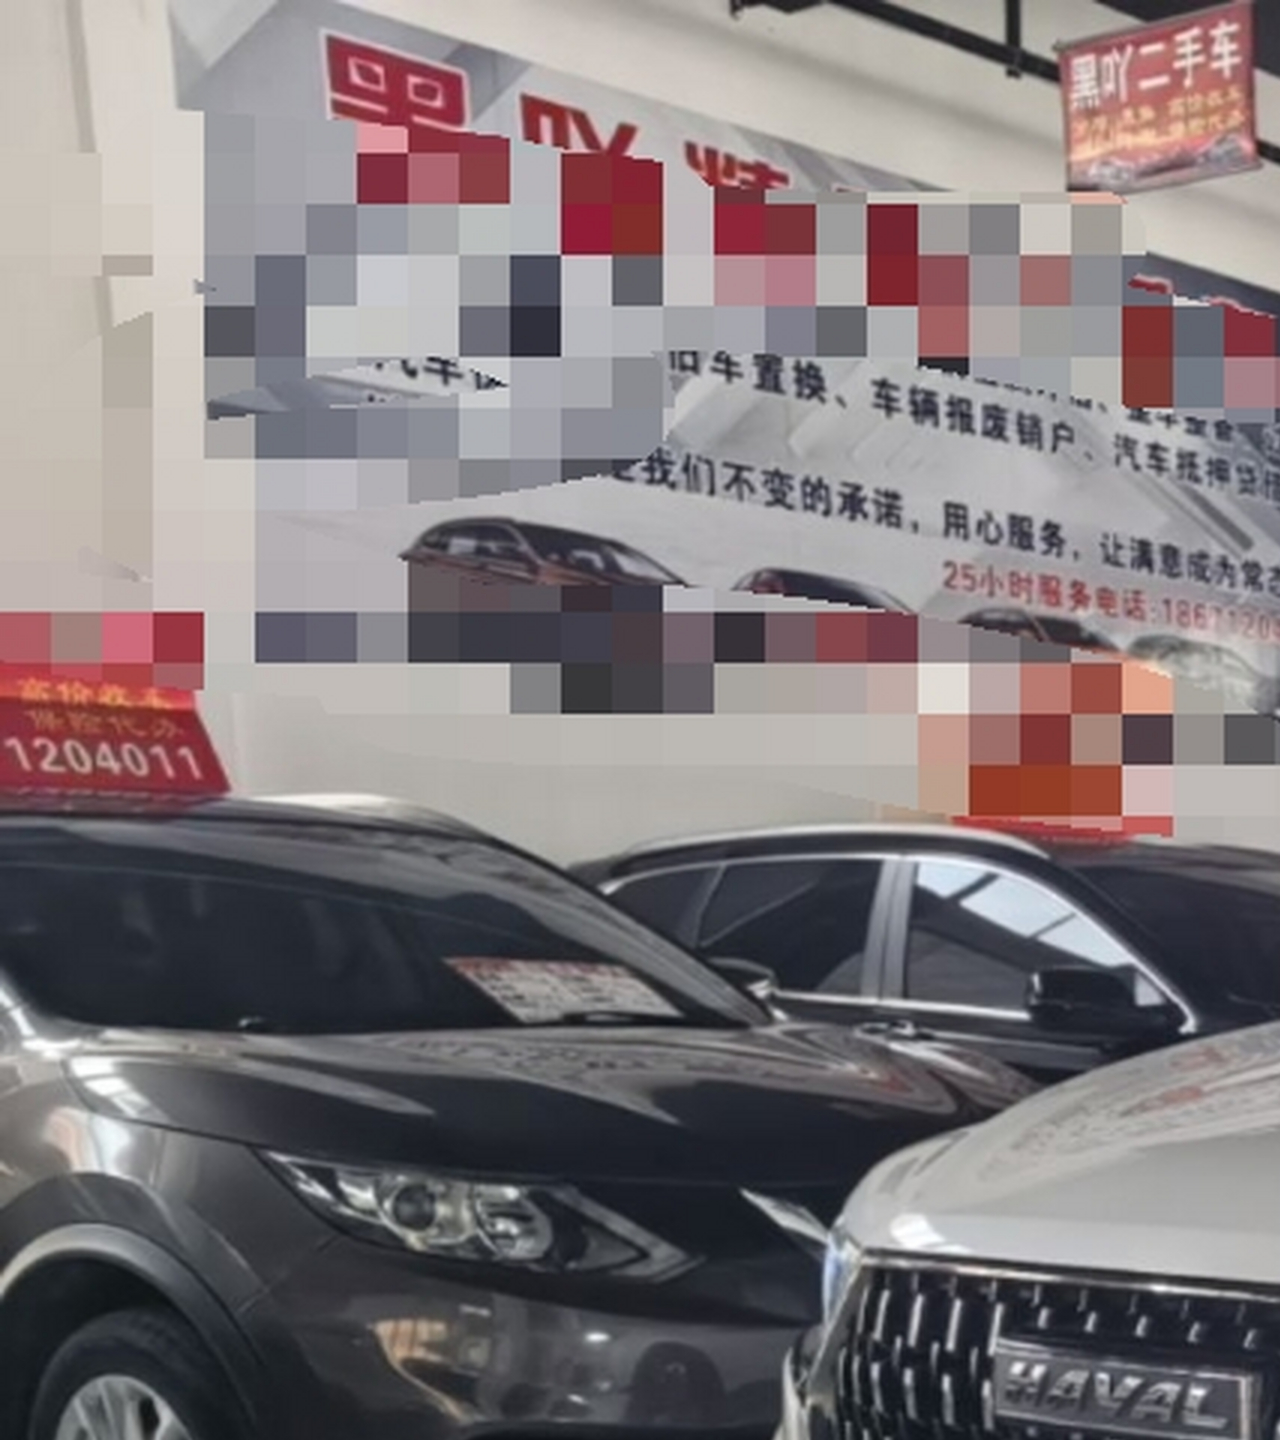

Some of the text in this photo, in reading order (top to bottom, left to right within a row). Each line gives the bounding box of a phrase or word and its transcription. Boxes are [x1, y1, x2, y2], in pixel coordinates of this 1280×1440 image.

[1070, 20, 1243, 108] 黑吖二手车
[5, 737, 202, 780] 1204011
[1005, 1361, 1228, 1429] HAVAL
